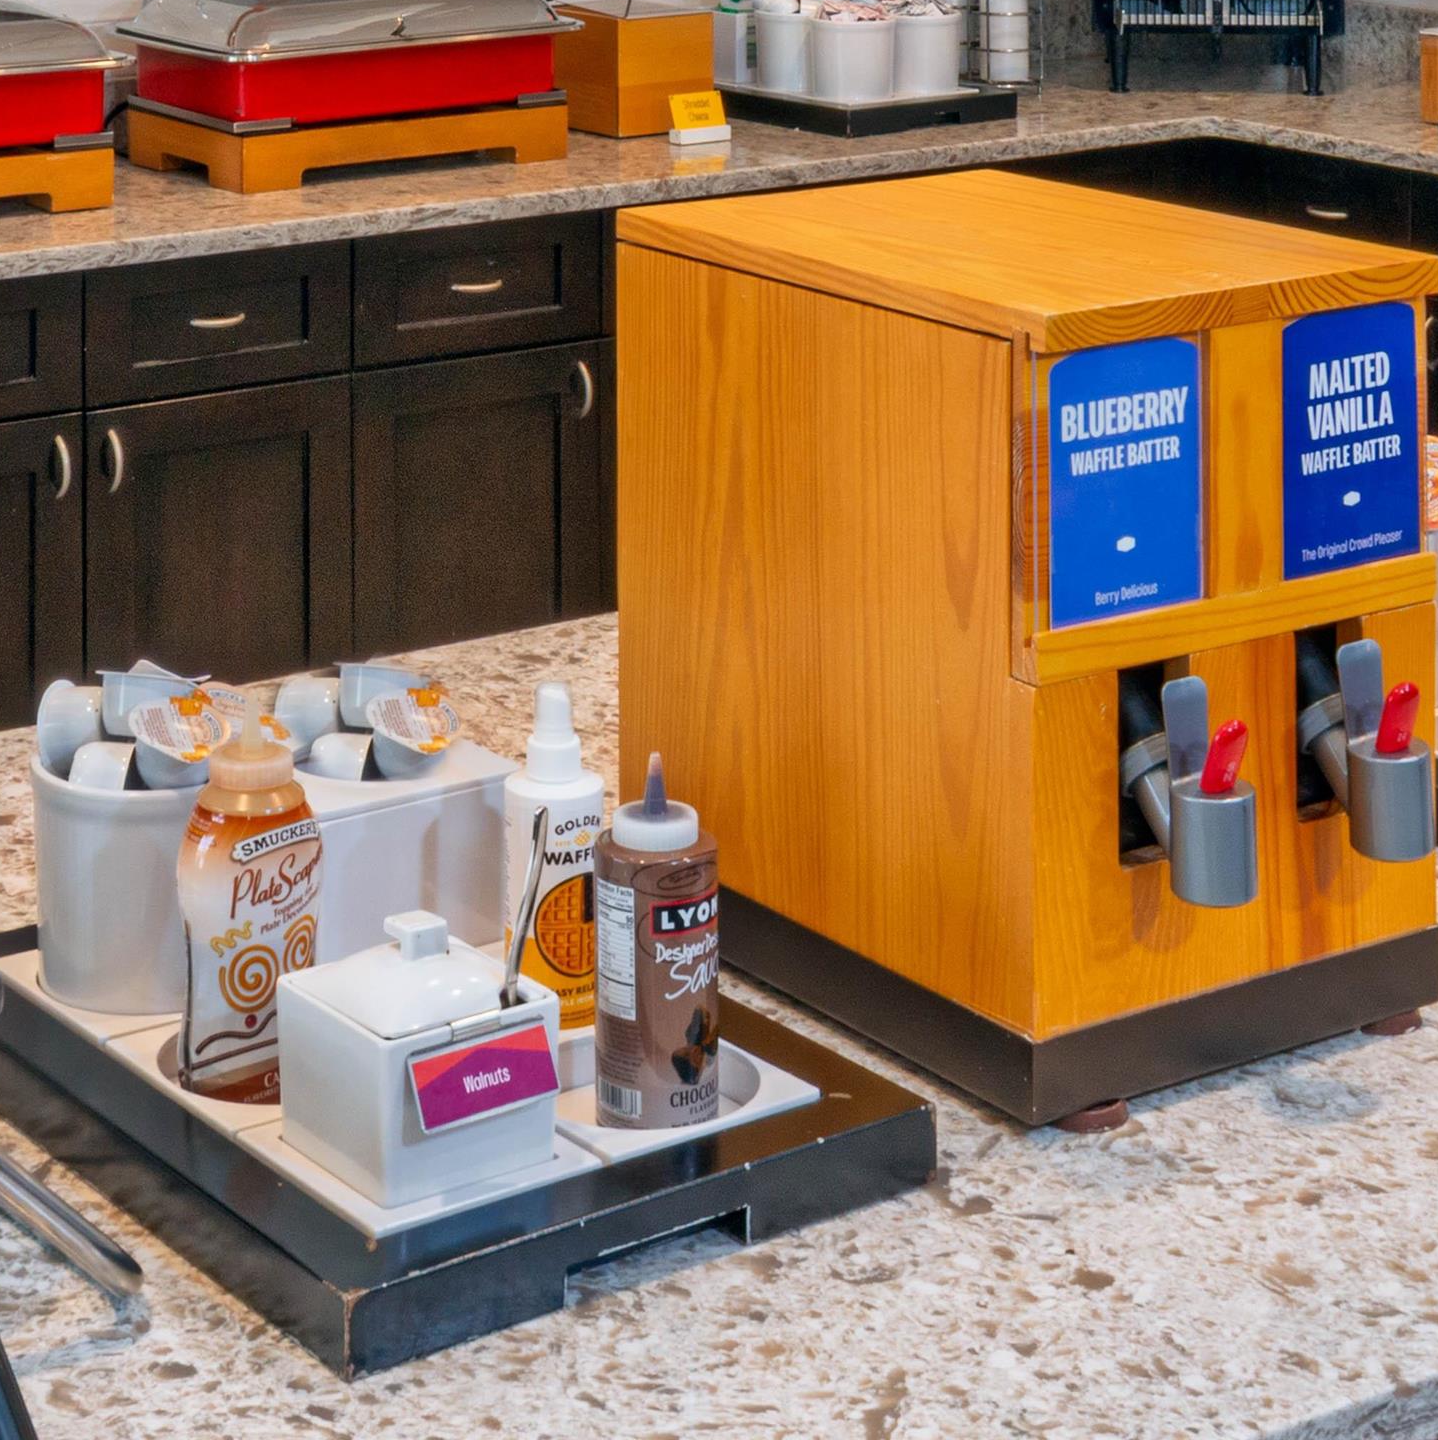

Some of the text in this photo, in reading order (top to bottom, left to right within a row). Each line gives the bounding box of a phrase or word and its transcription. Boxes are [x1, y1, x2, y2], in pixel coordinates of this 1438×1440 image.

[1308, 351, 1390, 400] MALTED
[1061, 386, 1189, 442] BLUEBERRY
[1307, 391, 1394, 441] VANILLA
[1070, 436, 1180, 477] WAFFLE BATTER
[1301, 446, 1351, 476] WAFFLE
[1352, 435, 1401, 465] BATTER
[1301, 528, 1403, 562] The Original Crowd Pleaser
[1094, 581, 1159, 607] Berry Delicious
[555, 815, 600, 835] GOLDEN
[463, 1064, 511, 1095] Walnuts
